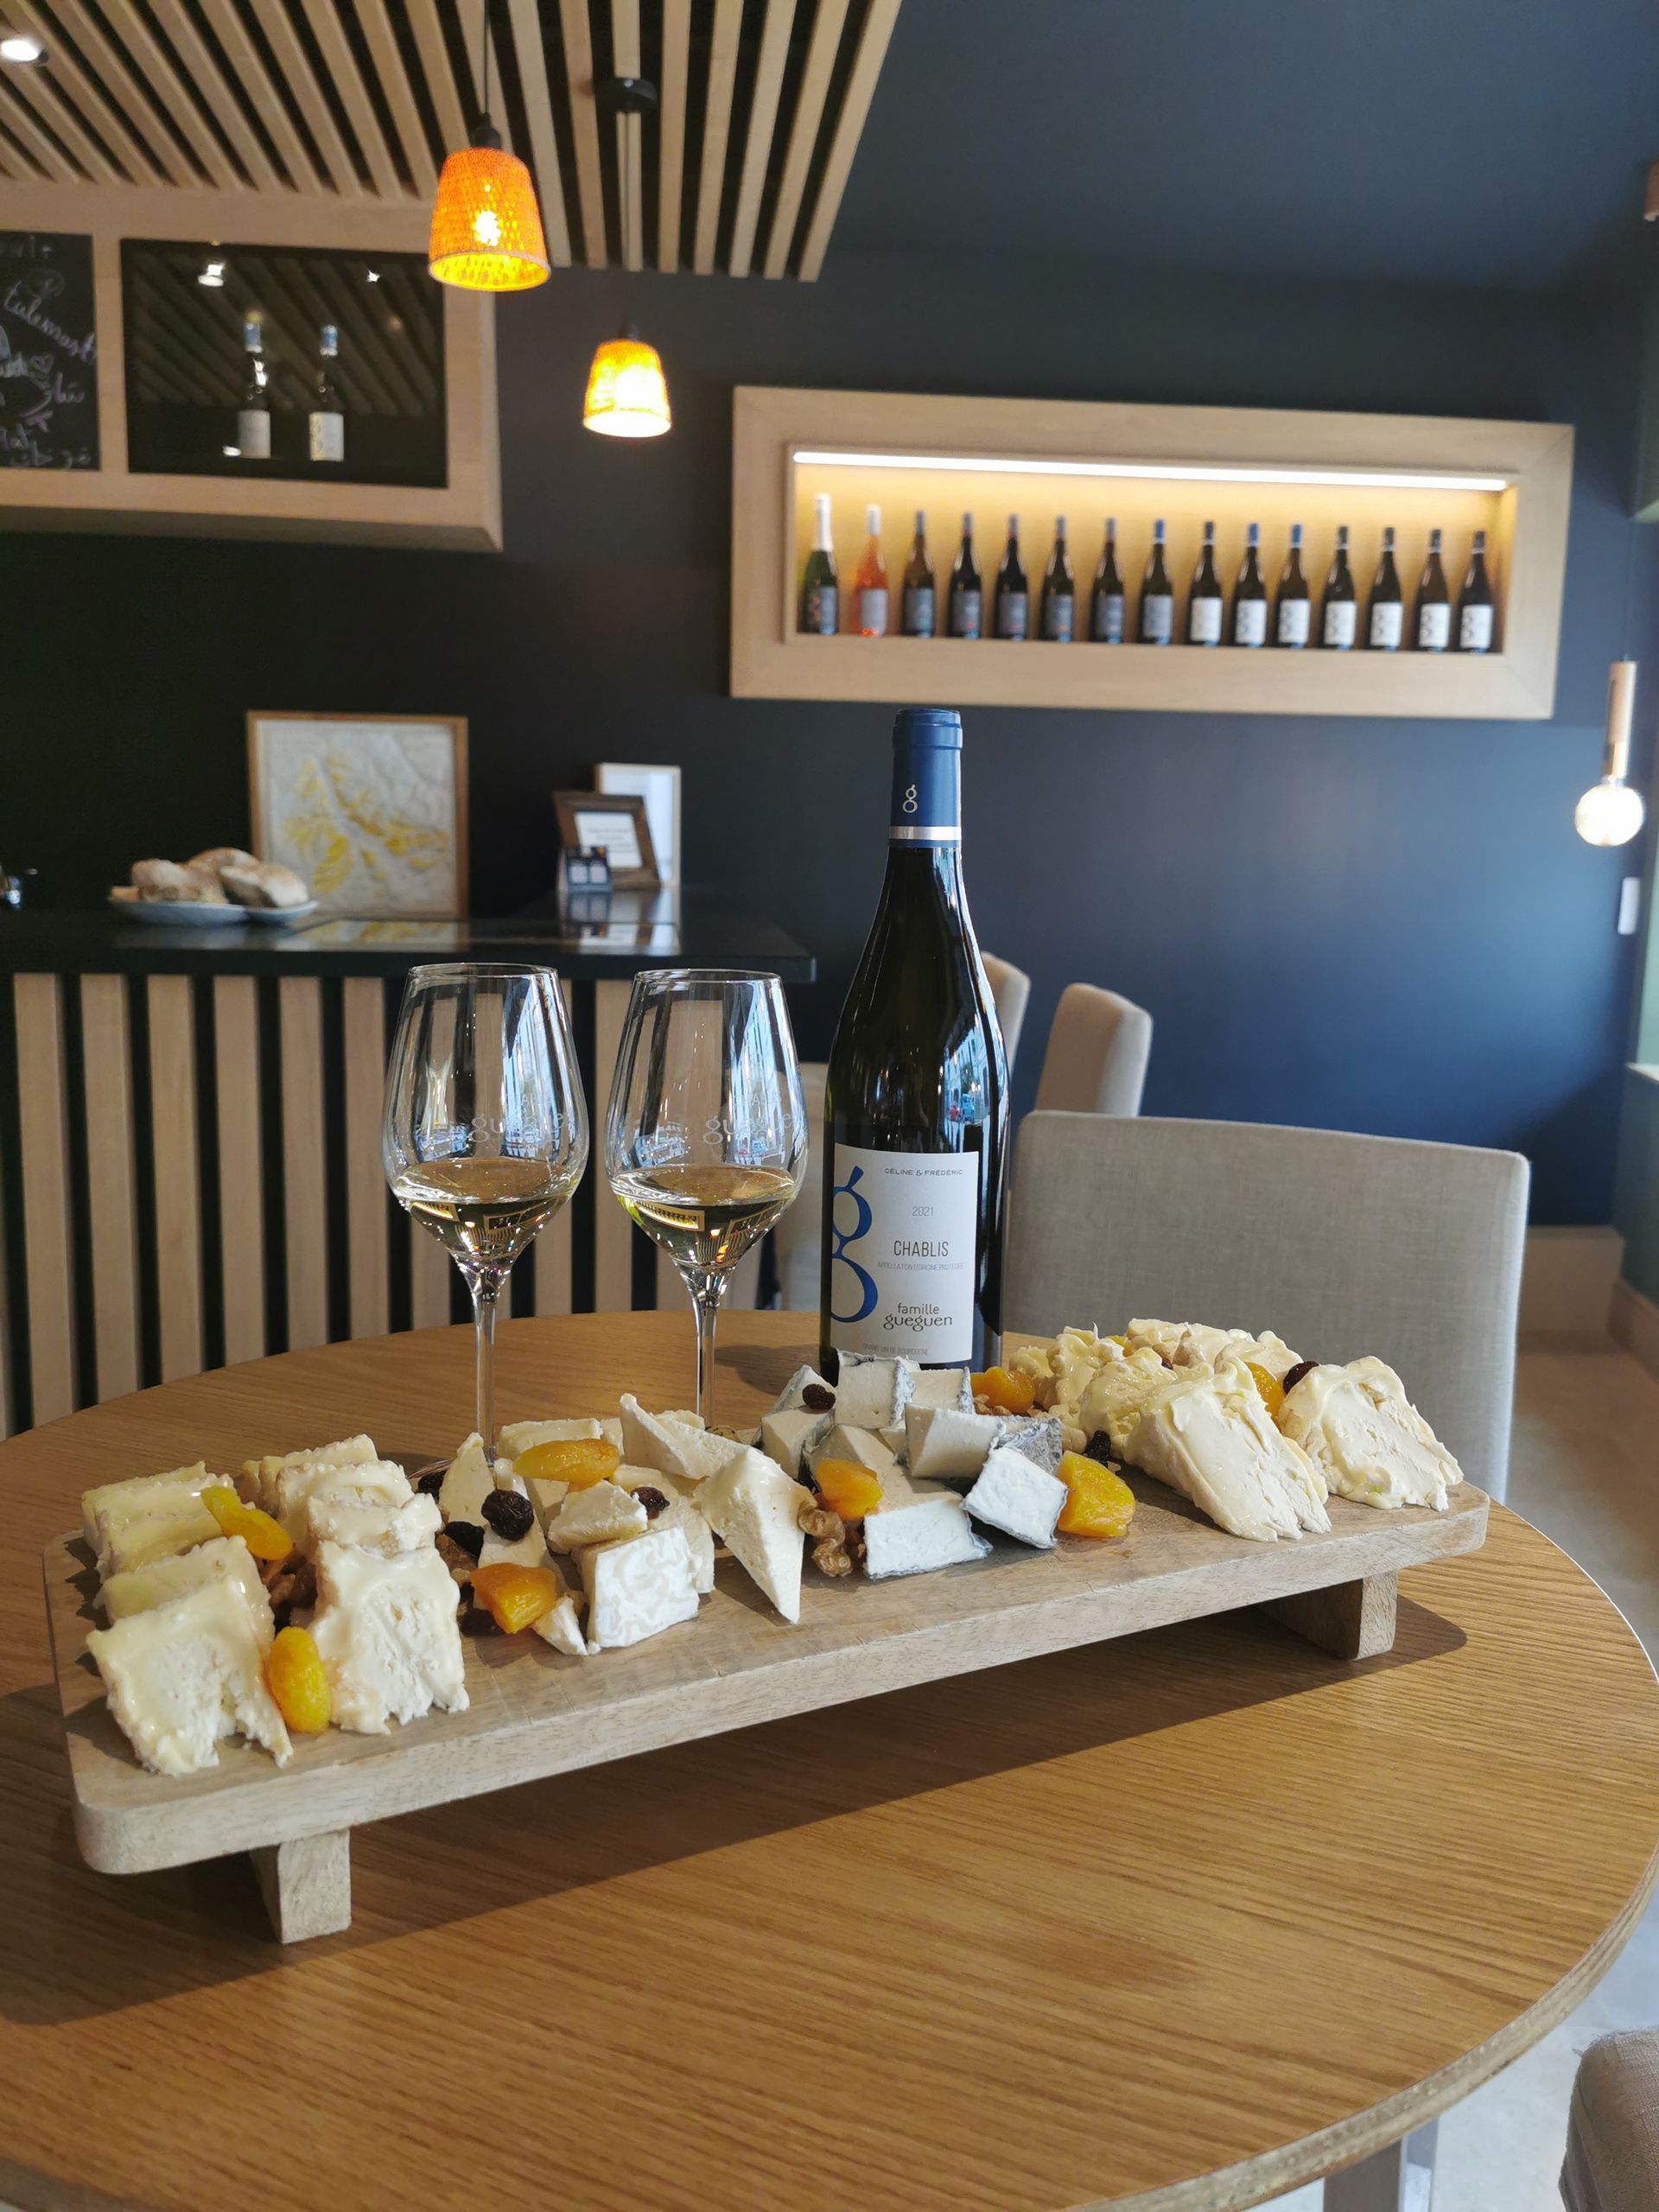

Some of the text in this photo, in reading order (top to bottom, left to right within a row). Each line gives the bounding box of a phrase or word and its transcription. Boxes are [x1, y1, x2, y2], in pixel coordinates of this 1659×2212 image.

[884, 1167, 913, 1176] CÉLINE
[912, 1205, 934, 1217] 2021
[893, 1240, 949, 1257] CHABLIS
[898, 1302, 940, 1314] famille
[883, 1313, 952, 1332] gueguen
